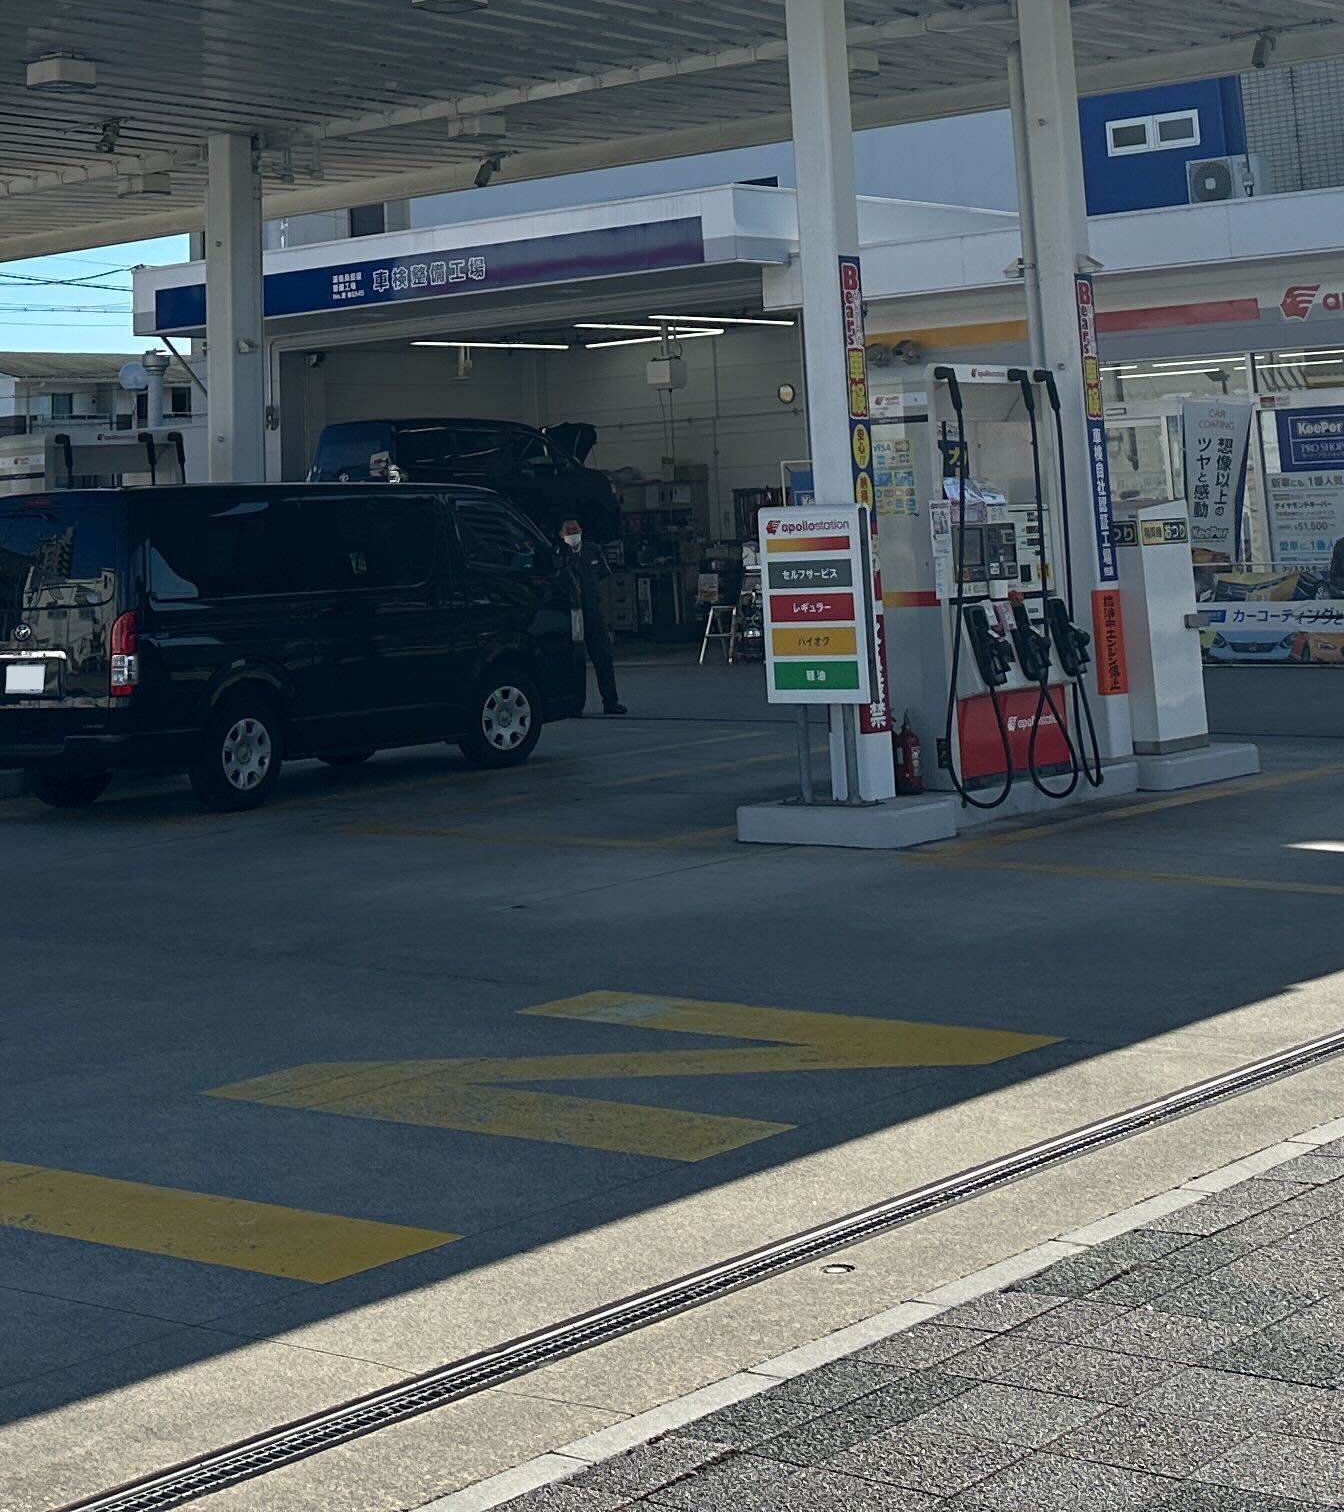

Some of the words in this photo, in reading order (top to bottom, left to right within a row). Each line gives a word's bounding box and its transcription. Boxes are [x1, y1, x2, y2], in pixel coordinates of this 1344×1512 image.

[372, 256, 486, 292] 車検整備工場
[1297, 421, 1343, 435] KeePer
[1301, 443, 1319, 453] PRO
[1320, 442, 1344, 452] SHOP
[1193, 438, 1211, 519] ツヤと感動
[1214, 438, 1233, 517] 想像以上の
[782, 520, 850, 534] apollostation
[782, 568, 838, 580] セルフサービス
[793, 602, 832, 613] レギュラー
[798, 636, 830, 646] ハイオク
